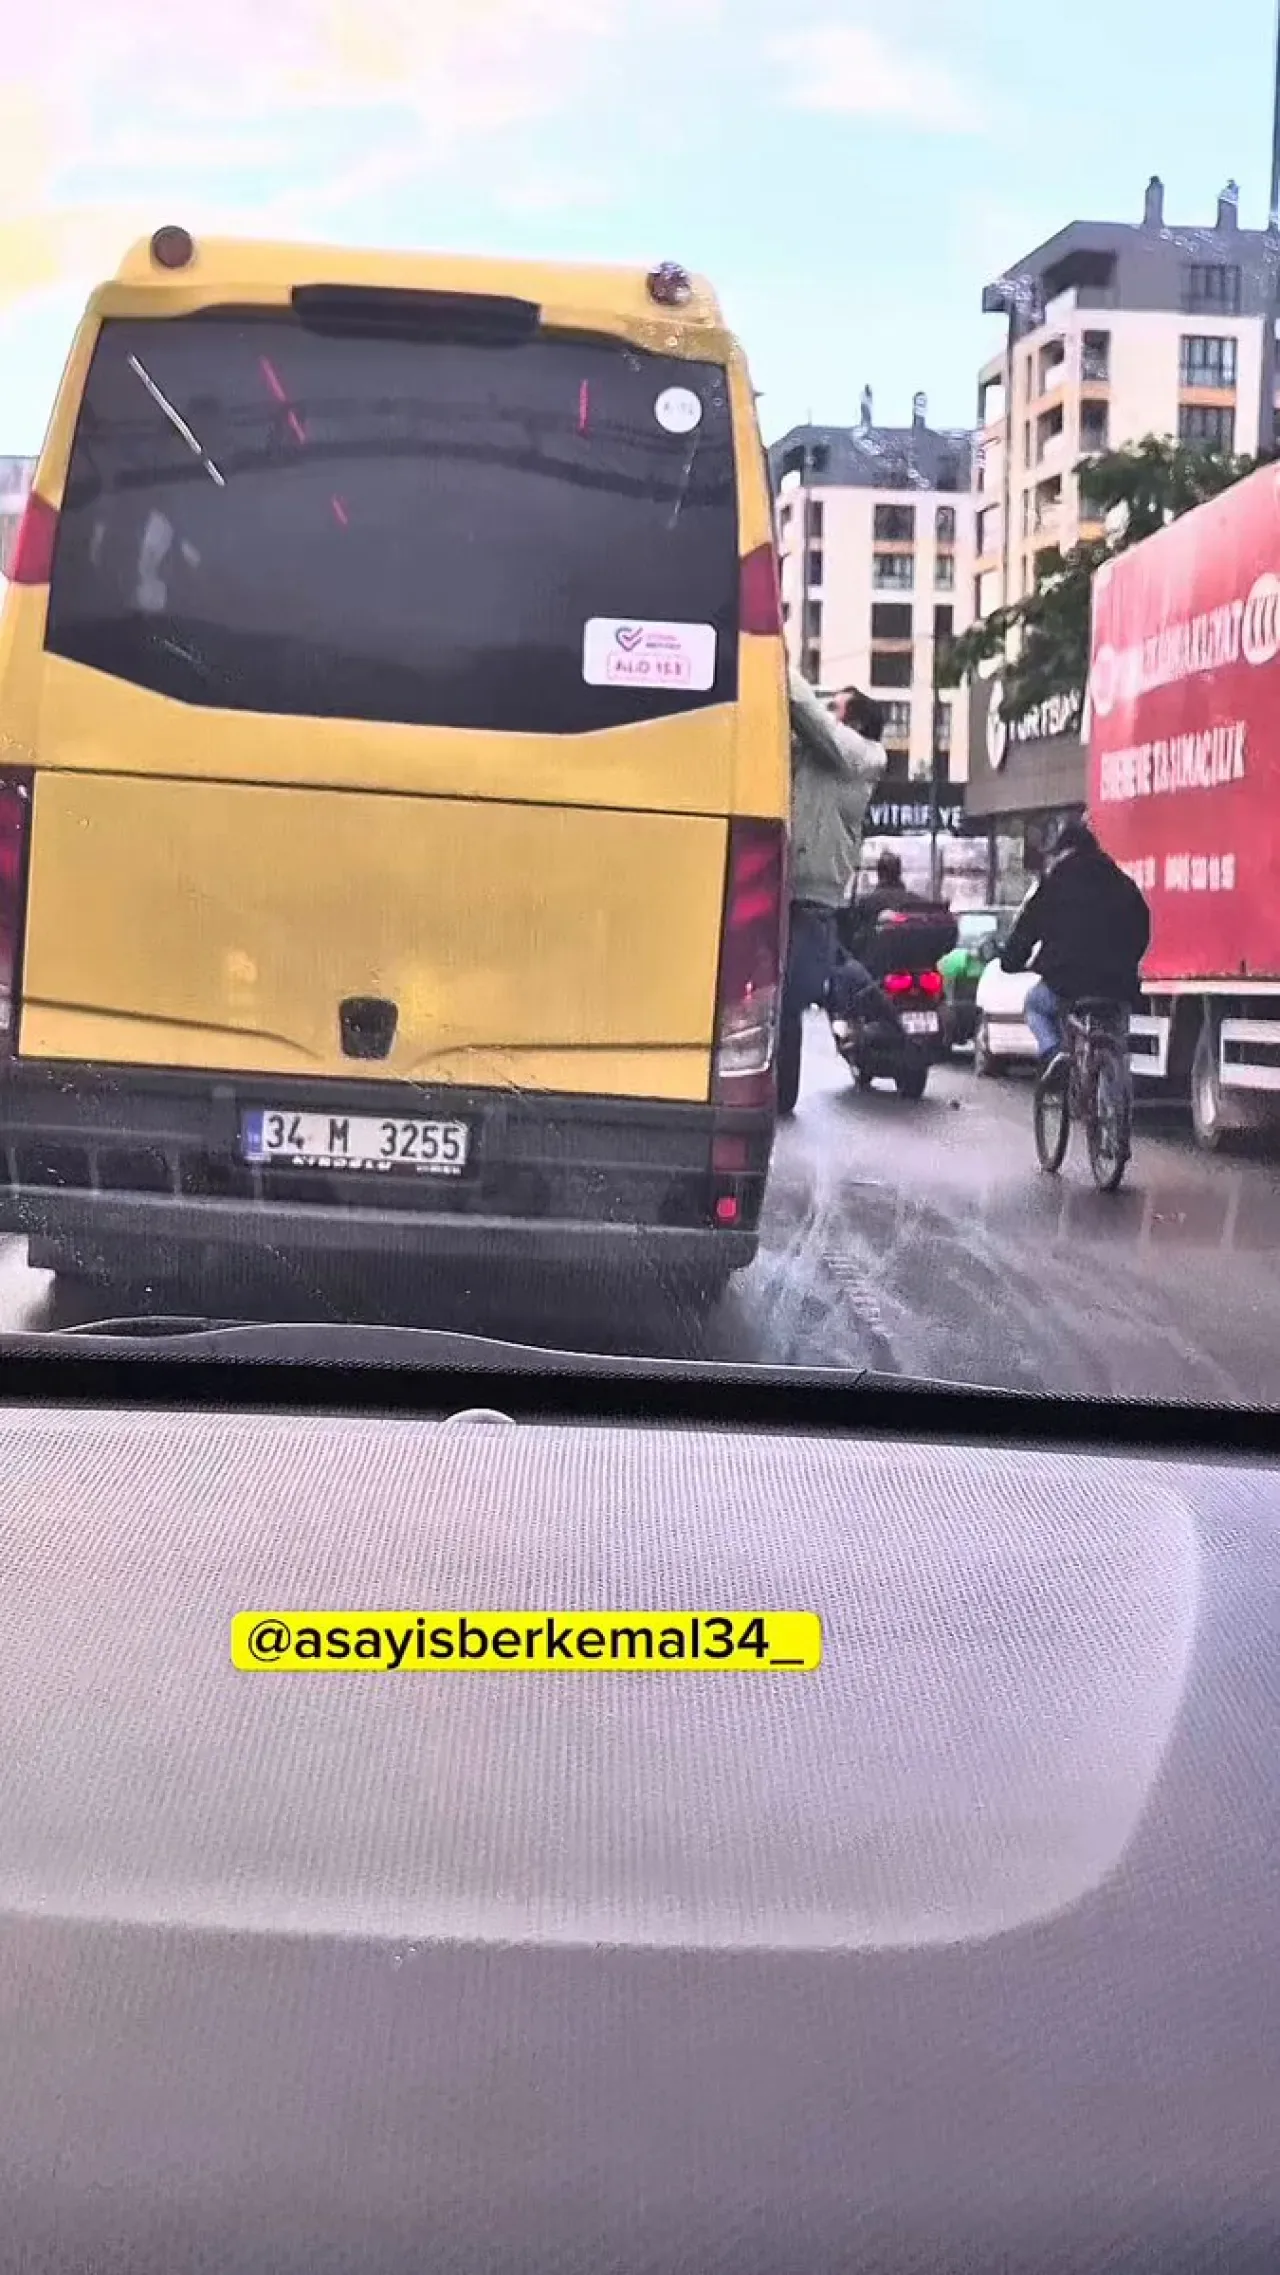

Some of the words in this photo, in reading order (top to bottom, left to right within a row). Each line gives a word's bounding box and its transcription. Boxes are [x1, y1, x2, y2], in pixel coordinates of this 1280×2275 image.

[266, 1114, 304, 1150] 34
[328, 1118, 349, 1153] M
[380, 1122, 460, 1160] 3255
